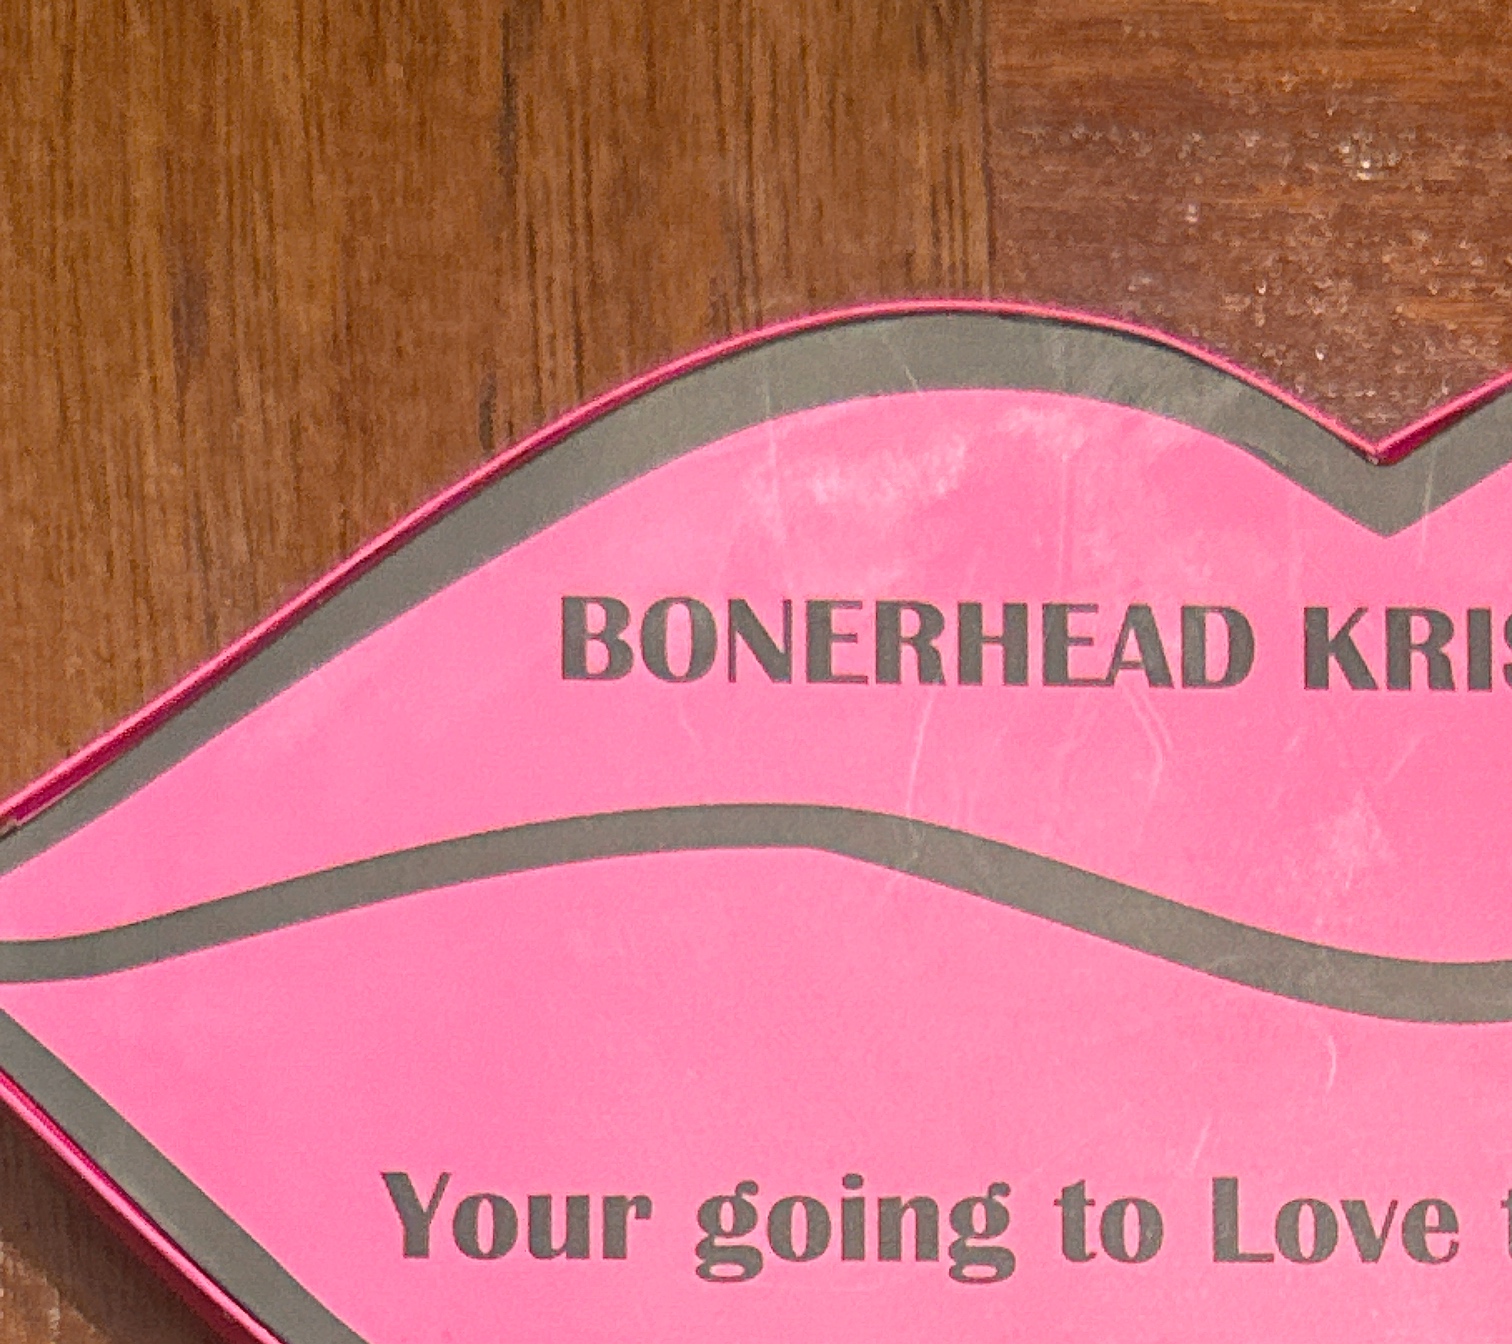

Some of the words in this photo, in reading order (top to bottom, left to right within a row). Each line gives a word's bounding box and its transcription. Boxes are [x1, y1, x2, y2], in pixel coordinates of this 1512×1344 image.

[562, 596, 1255, 688] BONERHEAD
[383, 1172, 652, 1262] Your
[696, 1174, 1016, 1283] going
[1055, 1182, 1163, 1263] to
[1213, 1178, 1459, 1264] Love
